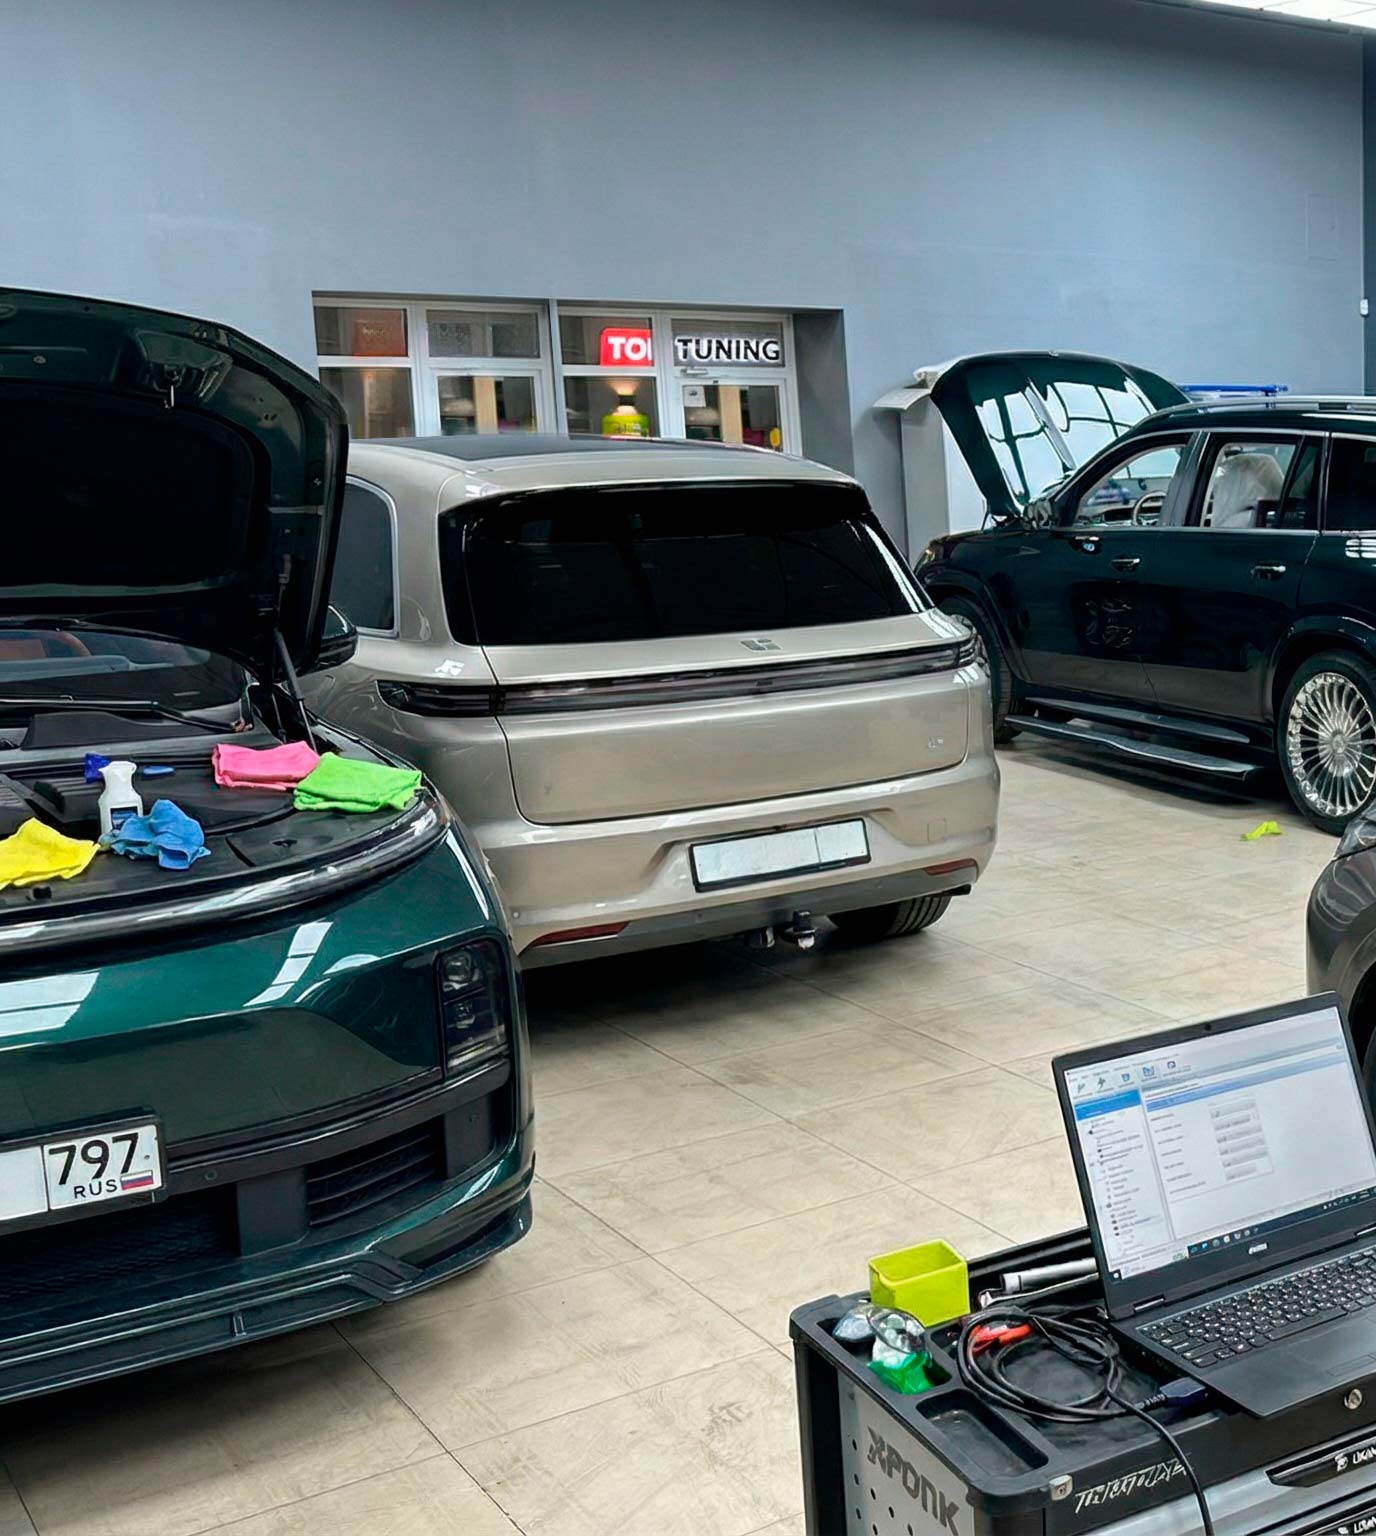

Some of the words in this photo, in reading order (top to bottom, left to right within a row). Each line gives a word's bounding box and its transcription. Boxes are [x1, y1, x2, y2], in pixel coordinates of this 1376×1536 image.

[676, 337, 781, 362] TUNING
[48, 1132, 139, 1186] 797
[73, 1178, 118, 1199] RUS
